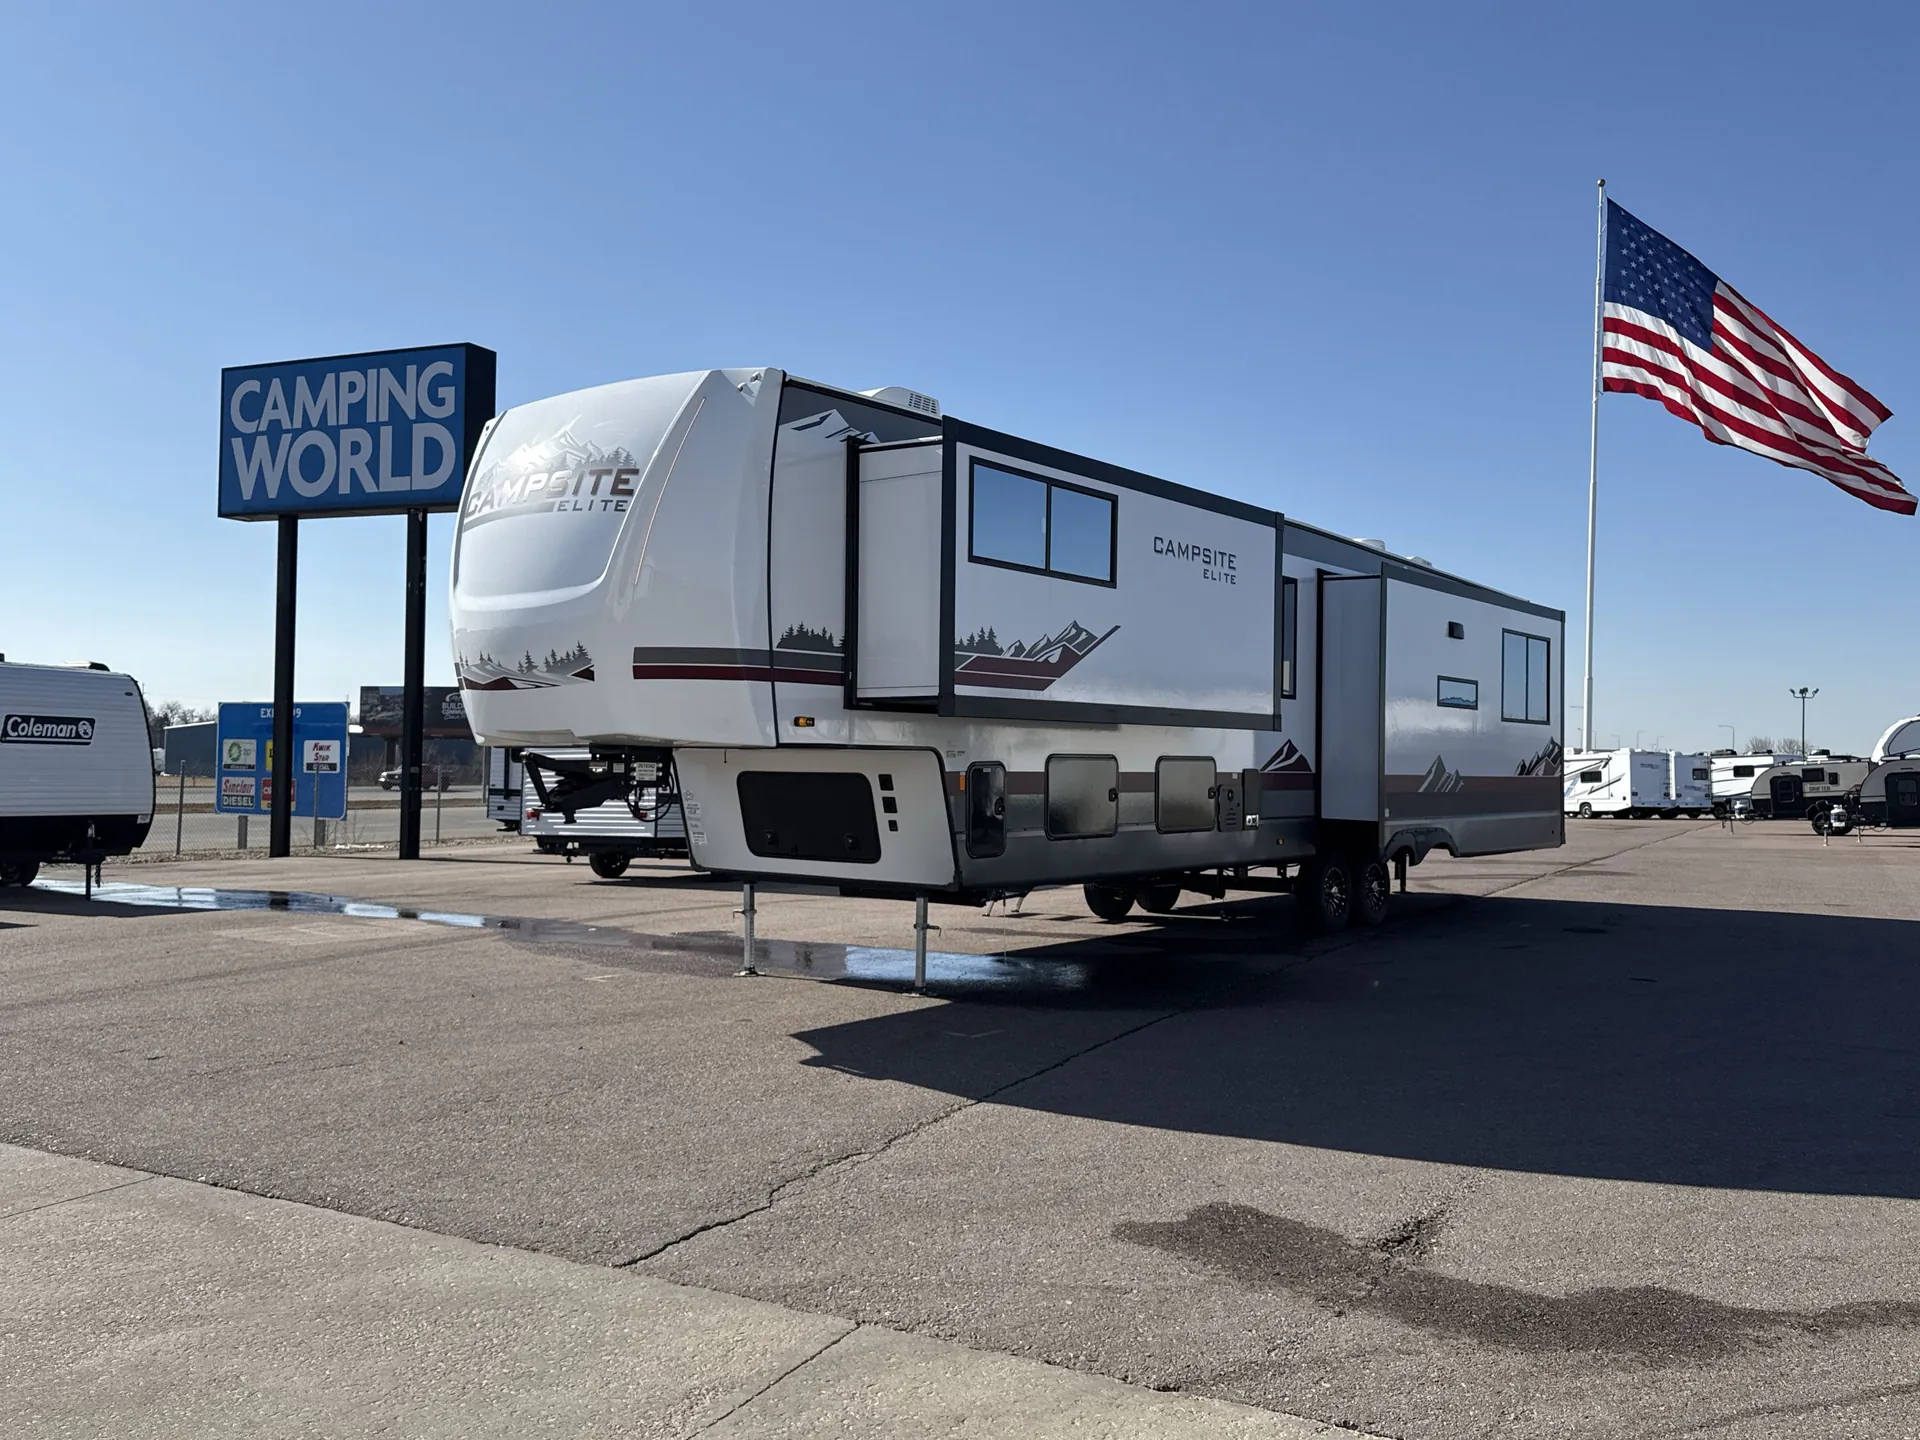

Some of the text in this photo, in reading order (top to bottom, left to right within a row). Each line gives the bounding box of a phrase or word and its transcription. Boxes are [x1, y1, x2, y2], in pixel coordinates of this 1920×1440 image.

[230, 360, 456, 434] CAMPING
[231, 422, 457, 501] WORLD
[465, 468, 640, 519] CAMPSITE
[556, 500, 629, 513] ELITE
[1153, 535, 1237, 571] CAMPSITE
[1203, 568, 1237, 585] ELITE
[260, 707, 274, 719] EXI
[7, 716, 77, 738] Coleman
[223, 779, 254, 794] Sinclair
[223, 795, 254, 806] DIESEL
